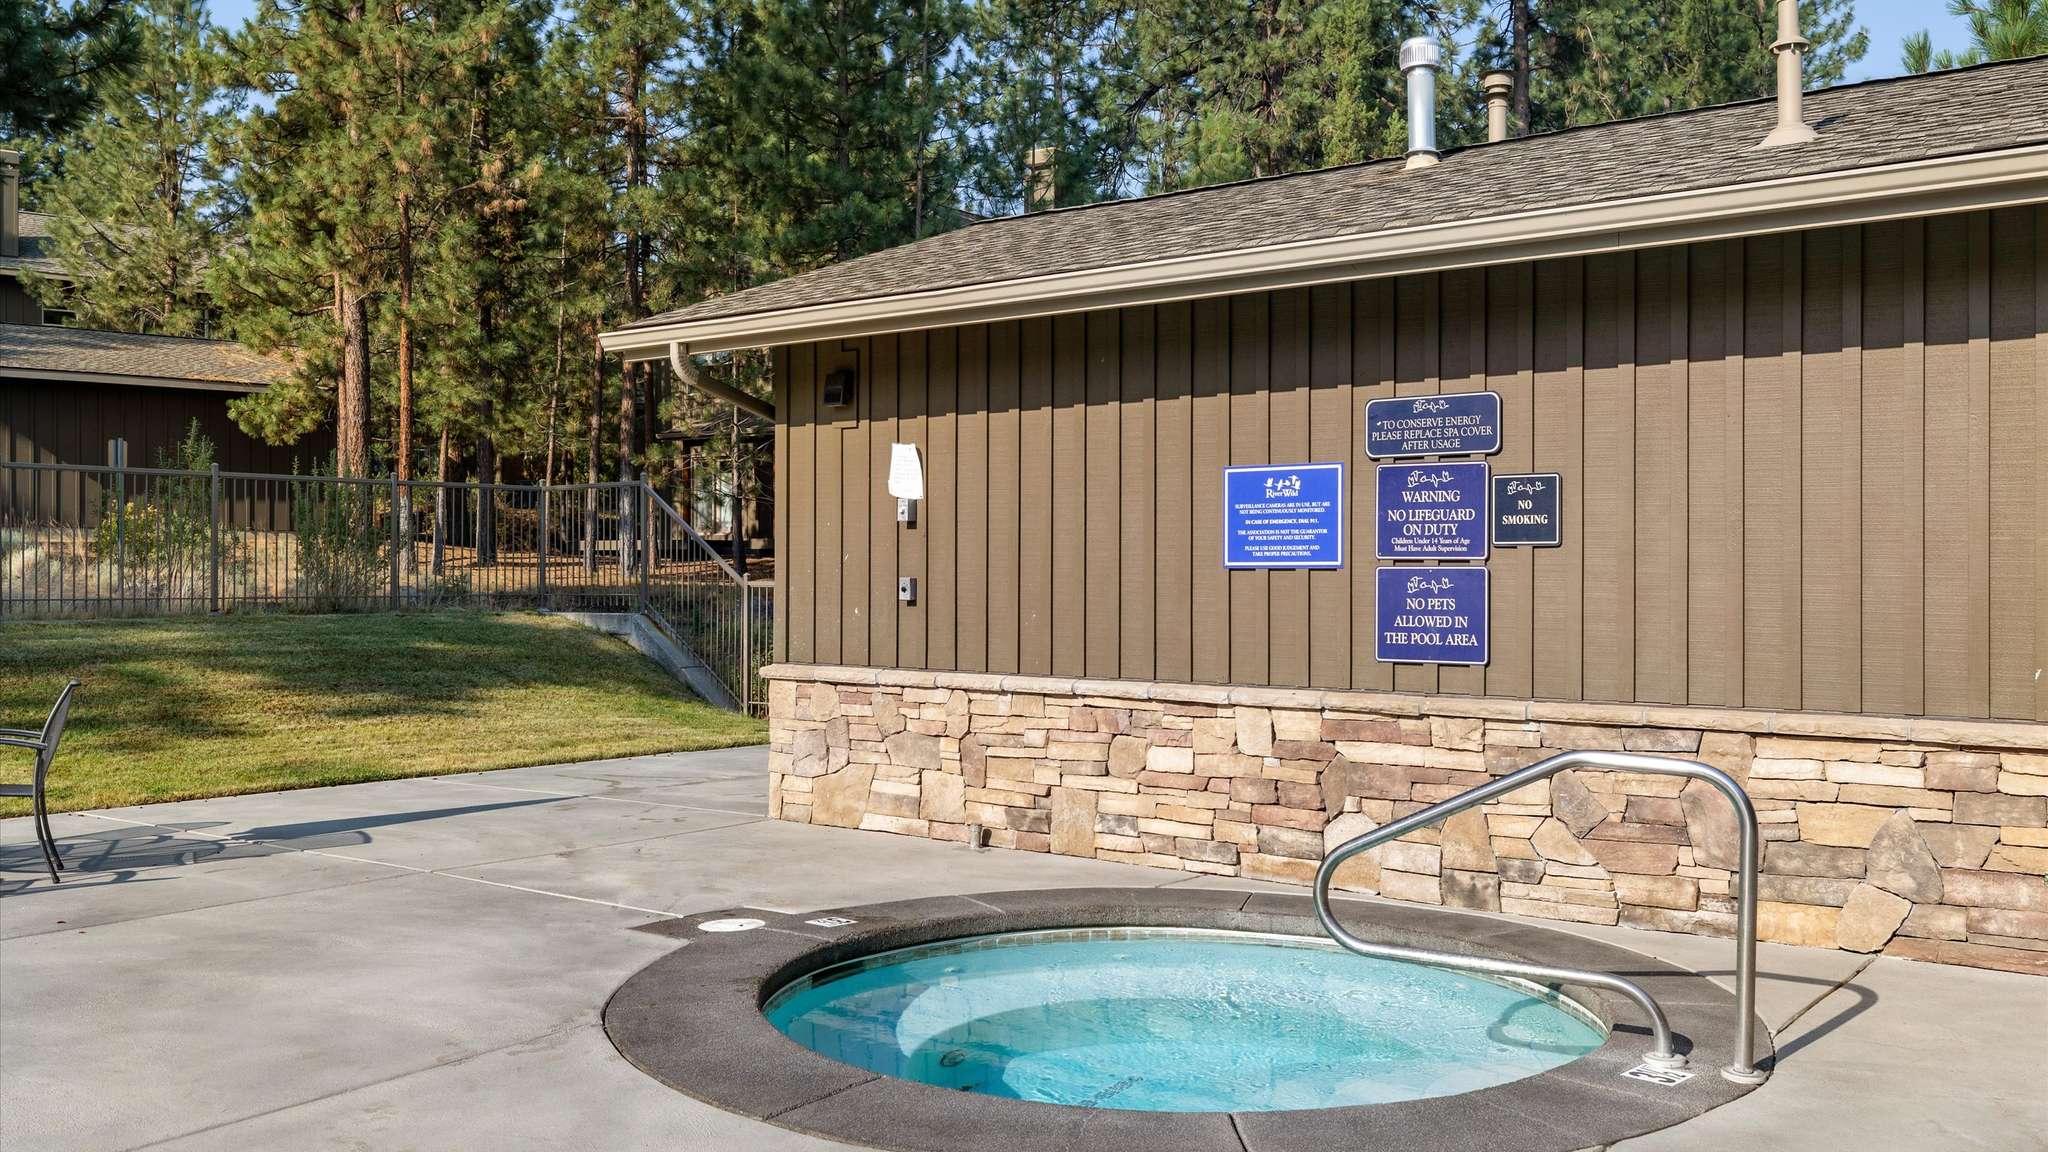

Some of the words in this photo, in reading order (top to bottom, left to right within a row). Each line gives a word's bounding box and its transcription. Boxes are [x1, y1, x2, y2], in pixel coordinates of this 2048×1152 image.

[1383, 420, 1395, 429] TO
[1397, 418, 1444, 428] CONSERVE
[1446, 416, 1481, 426] ENERGY
[1372, 430, 1402, 441] PLEASE
[1404, 429, 1442, 439] REPLACE
[1444, 428, 1459, 437] SPA
[1461, 426, 1493, 436] COVER
[1402, 440, 1429, 450] AFTER
[1431, 439, 1460, 448] USAGE
[1402, 491, 1460, 502] WARNING
[1518, 500, 1532, 510] NO
[1388, 510, 1405, 521] NO
[1409, 509, 1475, 521] LIFEGUARD
[1503, 515, 1548, 524] SMOKING
[1403, 525, 1421, 535] ON
[1424, 524, 1458, 535] DUTY
[1460, 538, 1470, 546] Age
[1406, 599, 1424, 610] NO
[1428, 599, 1455, 610] PETS
[1394, 616, 1452, 628] ALLOWED
[1455, 617, 1468, 628] IN
[1385, 633, 1408, 644] THE
[1411, 634, 1442, 645] POOL
[1446, 634, 1478, 646] AREA
